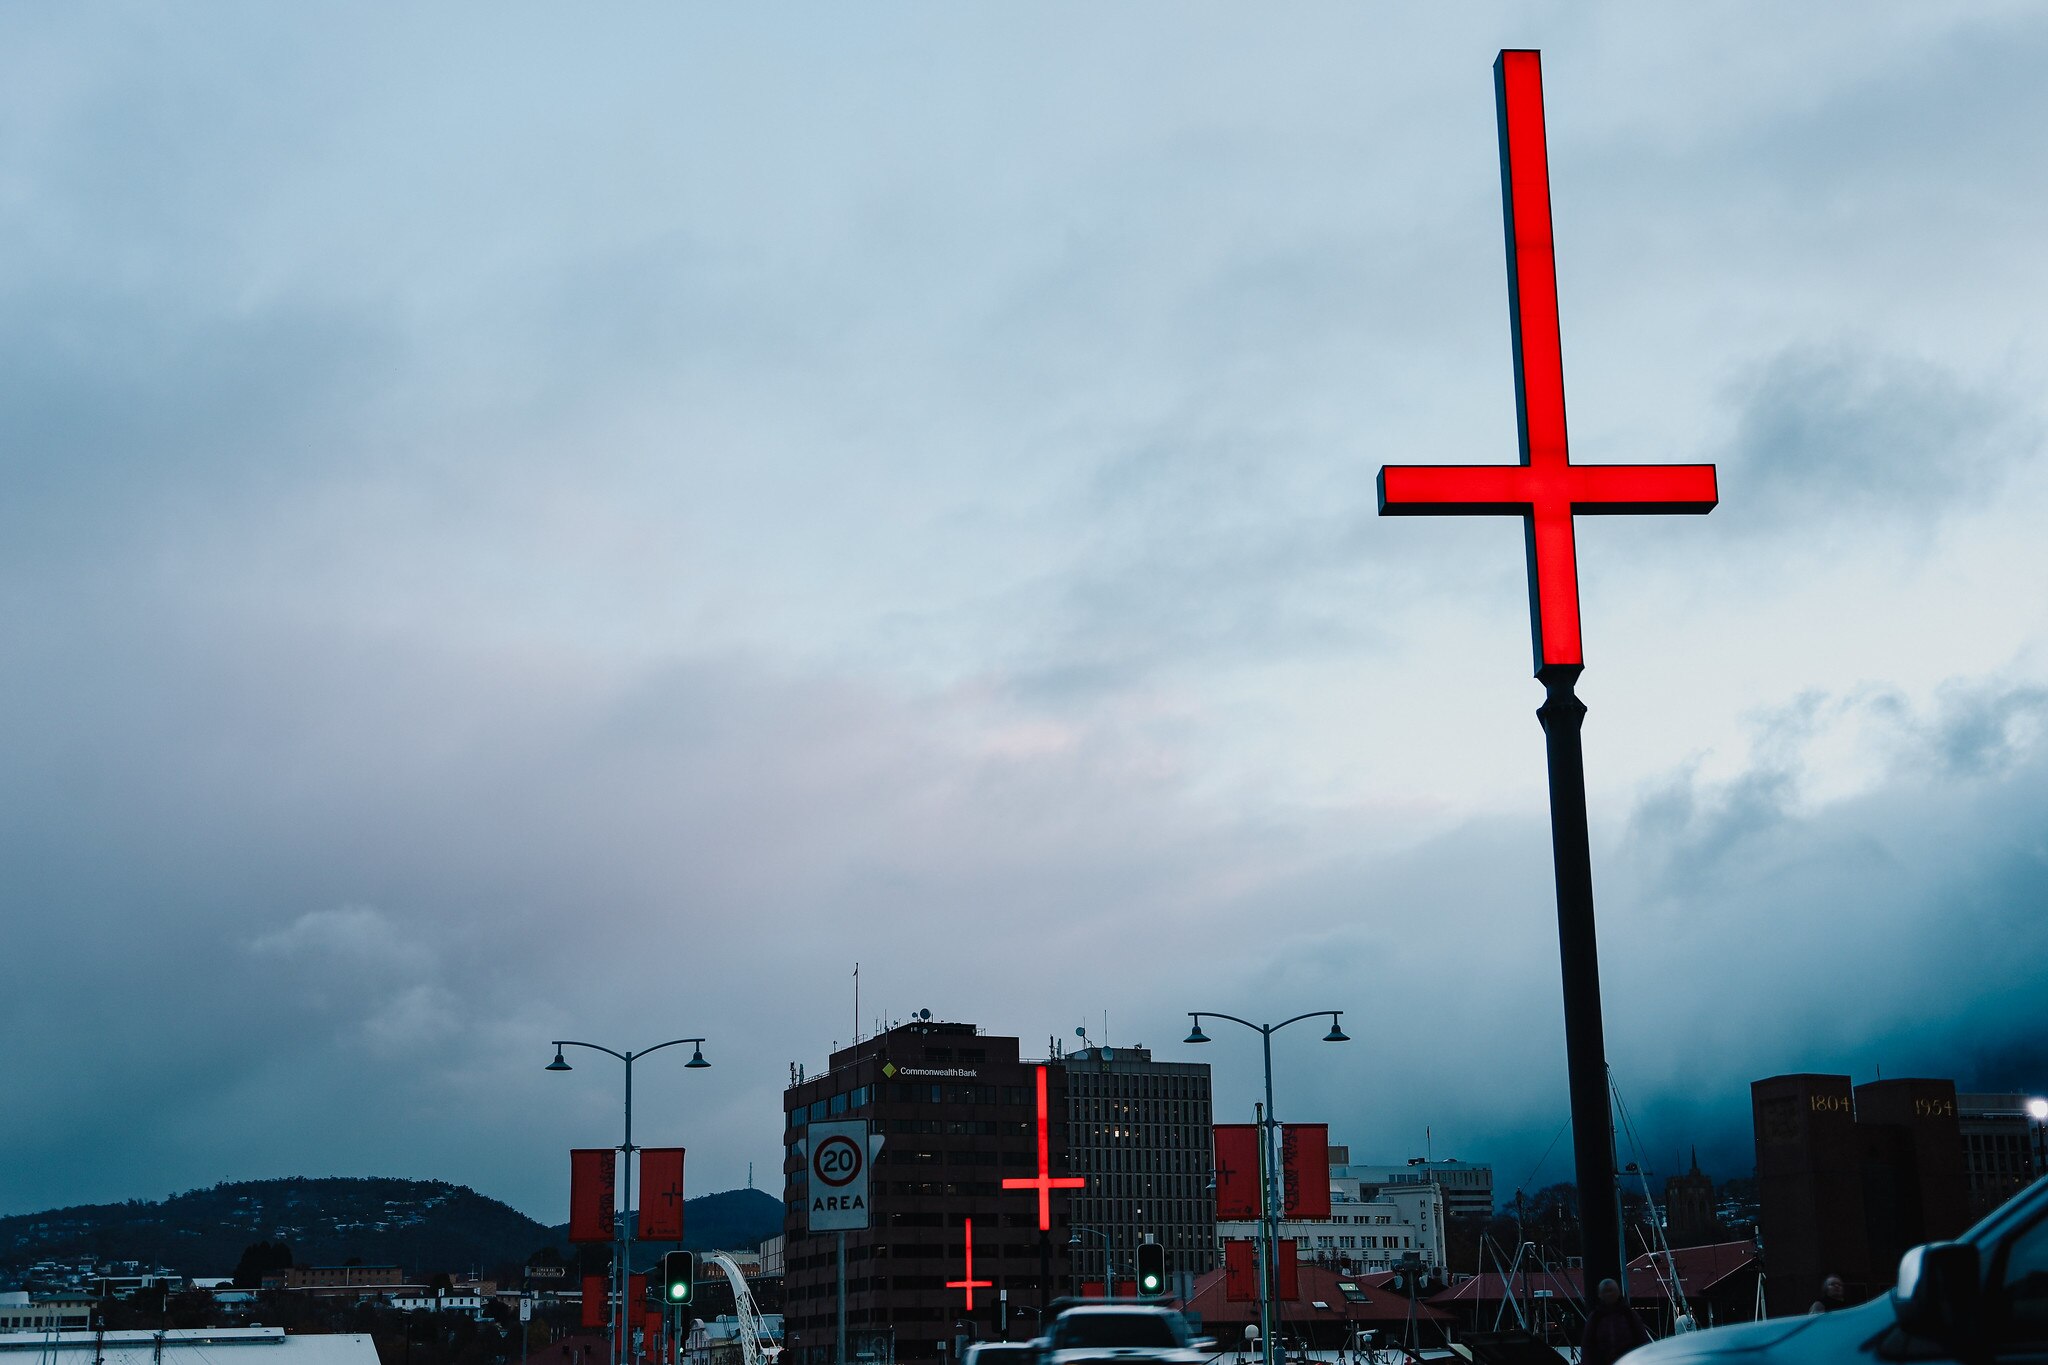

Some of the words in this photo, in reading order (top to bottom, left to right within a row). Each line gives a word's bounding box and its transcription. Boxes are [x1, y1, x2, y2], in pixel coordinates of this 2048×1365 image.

[1810, 1095, 1850, 1112] 1804
[1915, 1098, 1953, 1116] 1954
[823, 1149, 853, 1172] 20
[813, 1194, 865, 1211] AREA
